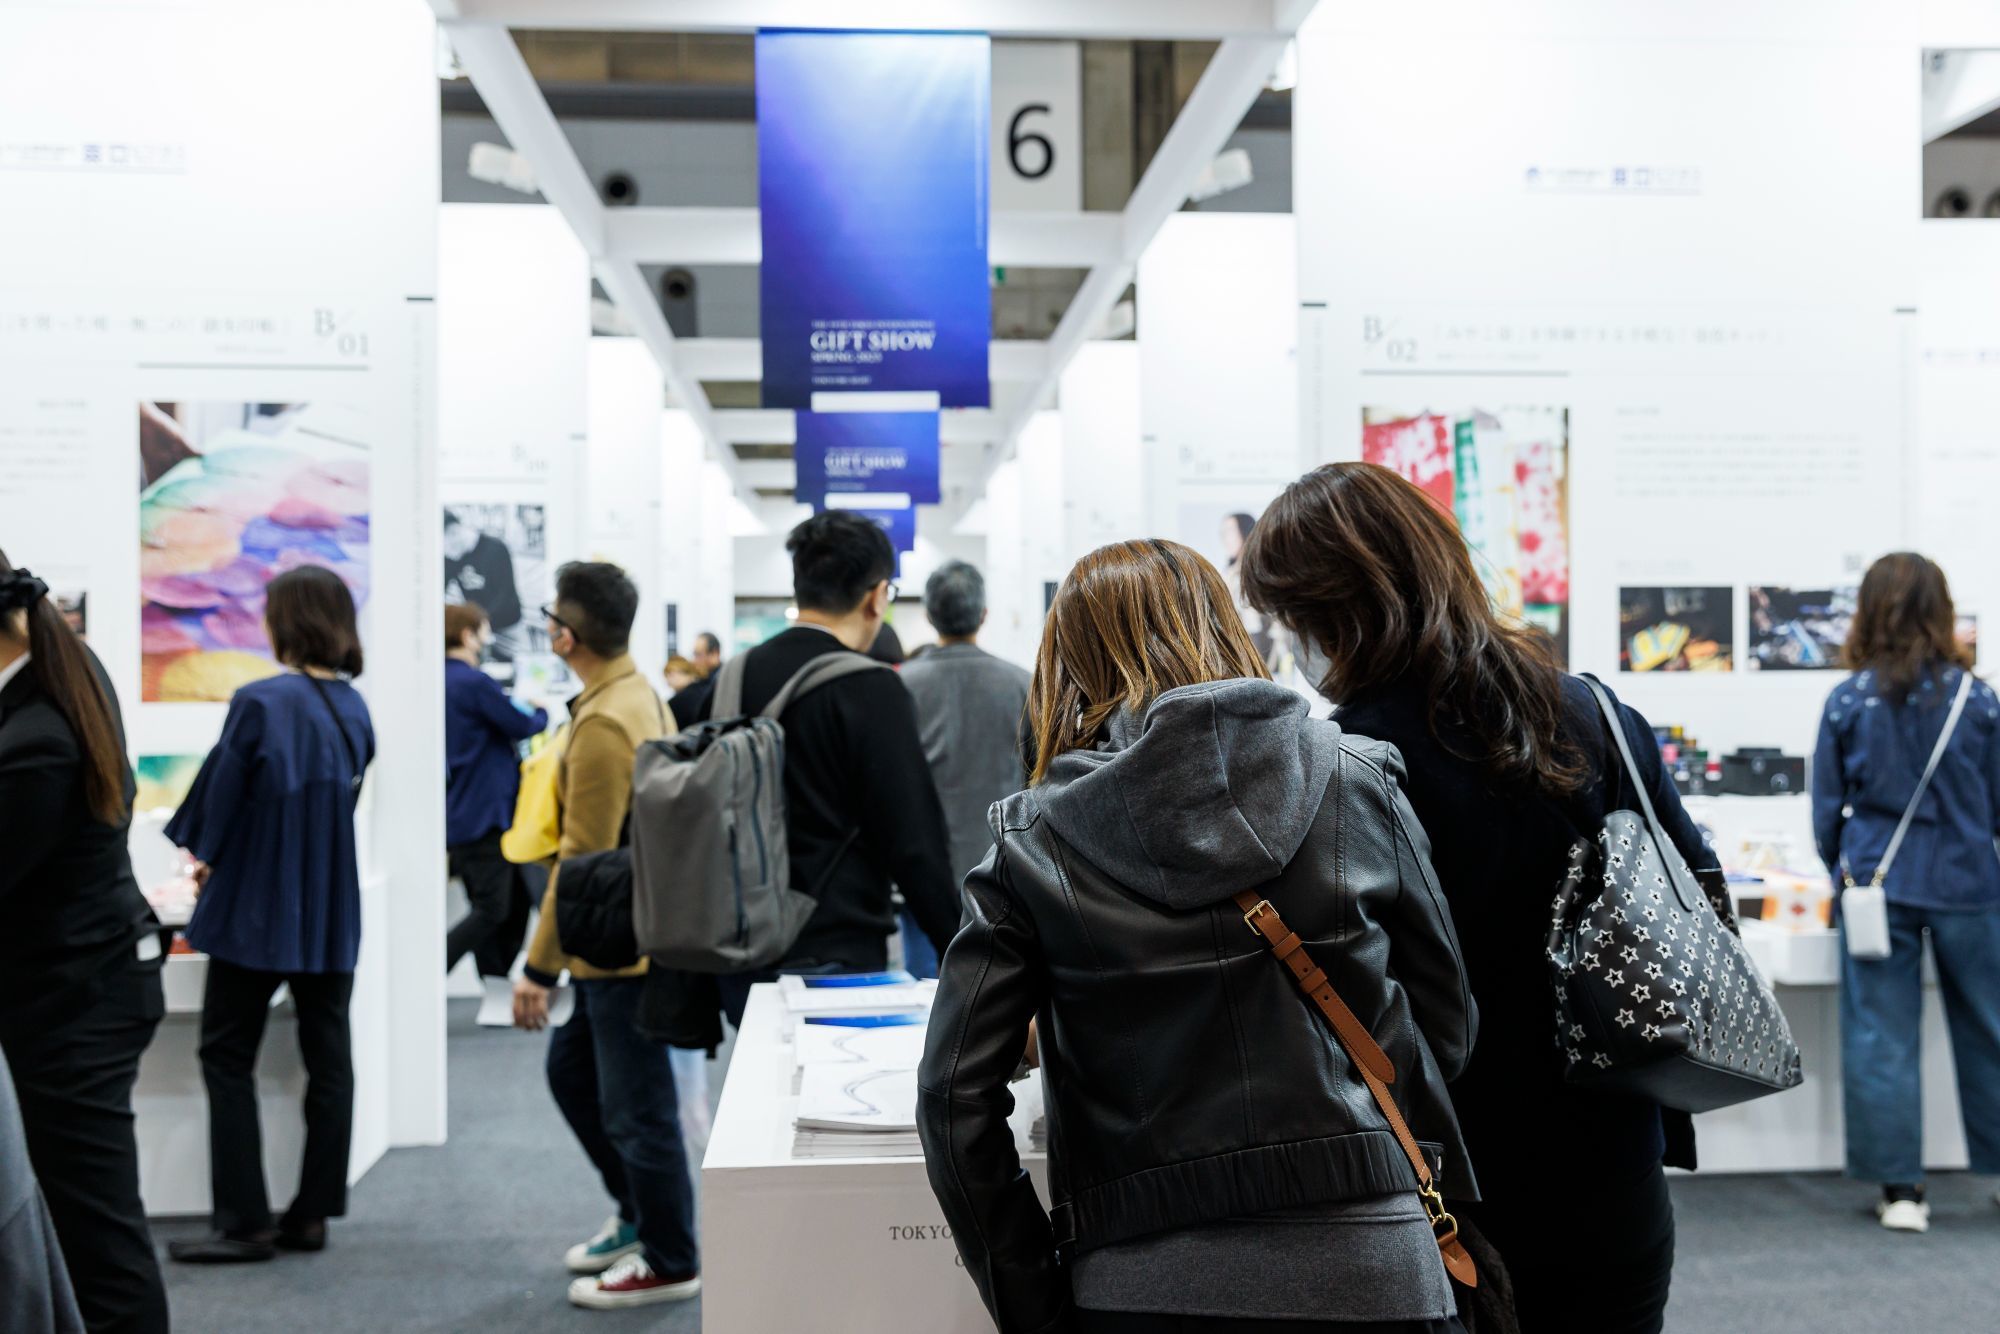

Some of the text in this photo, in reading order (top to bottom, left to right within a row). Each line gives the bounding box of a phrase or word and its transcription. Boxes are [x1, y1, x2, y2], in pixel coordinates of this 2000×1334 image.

[1006, 102, 1054, 180] 6
[810, 330, 936, 351] GIFT SHOW
[889, 1225, 953, 1241] TOKYO
